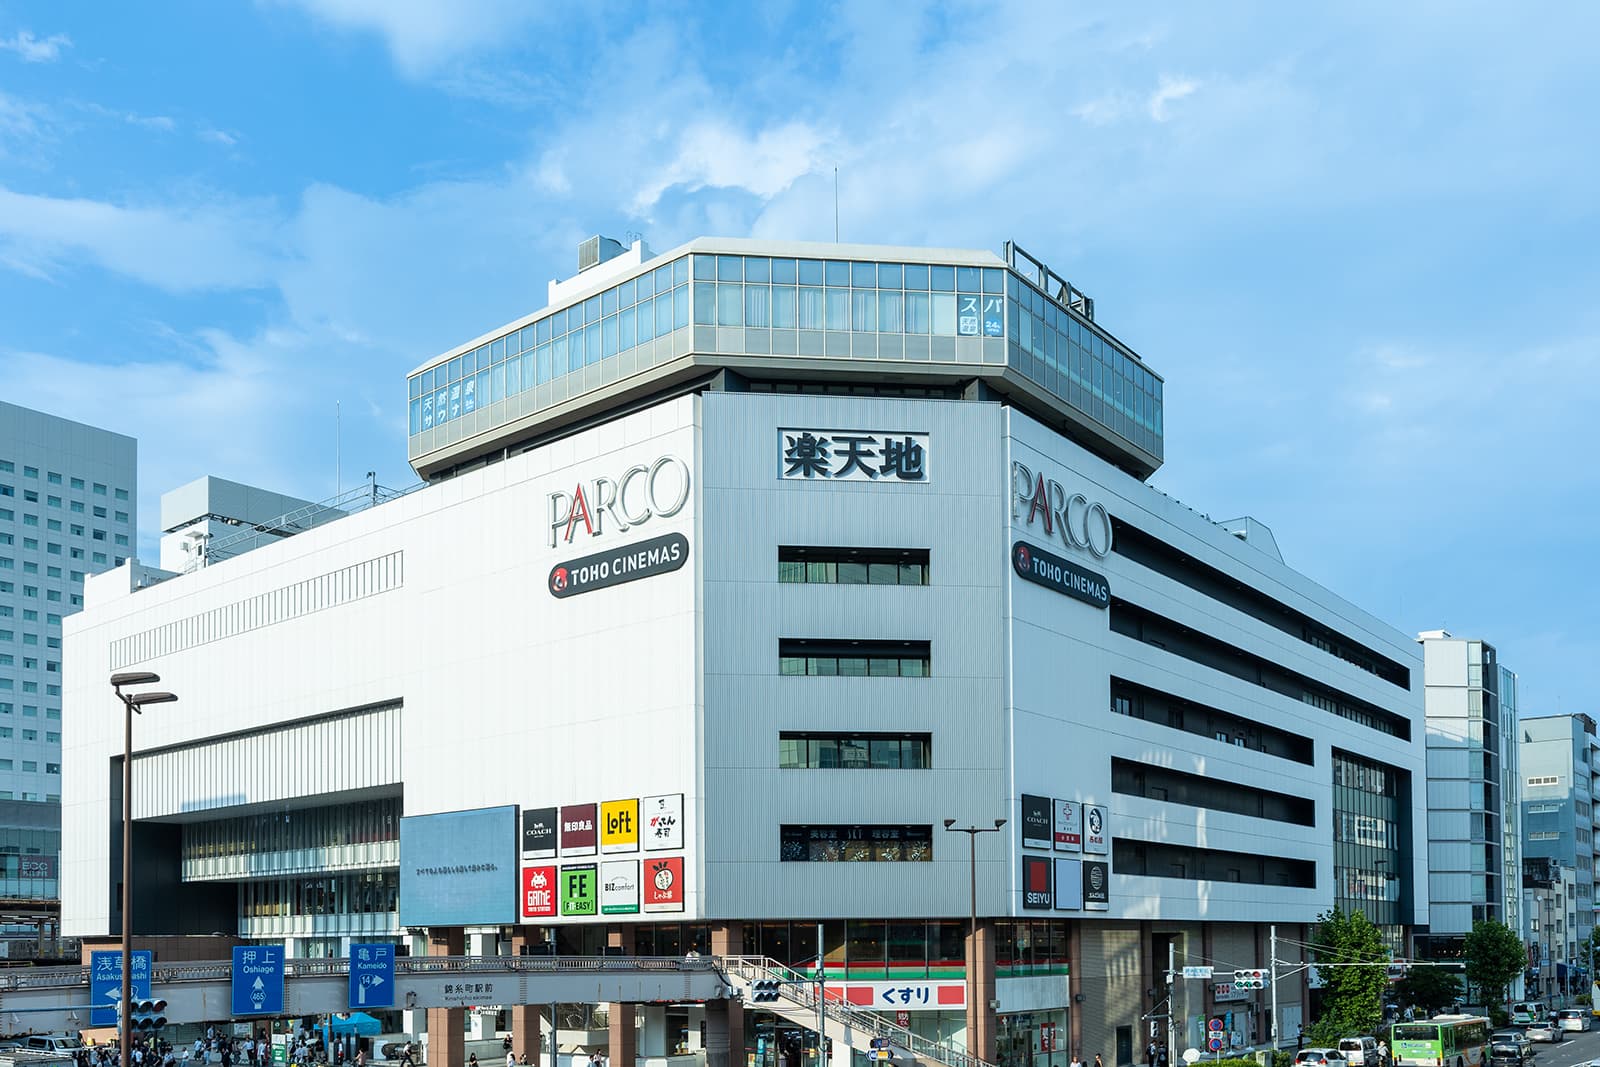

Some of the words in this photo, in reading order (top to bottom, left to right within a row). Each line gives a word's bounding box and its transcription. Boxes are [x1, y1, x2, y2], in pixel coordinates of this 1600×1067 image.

[961, 297, 1003, 313] スパ
[784, 432, 925, 480] 楽天地
[546, 455, 691, 548] PARCO
[1012, 460, 1113, 559] PARCO
[571, 562, 609, 585] TOHO
[612, 543, 681, 575] CINEMAS
[1032, 557, 1062, 583] TOHO
[1063, 570, 1108, 601] CINEMAS
[564, 819, 593, 833] 無印良品
[1026, 816, 1048, 825] COACH
[526, 828, 552, 836] COACH
[22, 862, 48, 871] ECC
[527, 890, 551, 907] GAME
[1027, 892, 1050, 904] SEIYU
[242, 950, 276, 965] 押上
[357, 947, 388, 960] 亀戸
[242, 965, 275, 975] Oshiage
[357, 961, 388, 970] Kameido
[96, 972, 147, 982] Asakusashi
[361, 975, 371, 984] 14
[444, 983, 493, 994] 錦糸町駅前
[252, 992, 265, 1002] 465
[881, 987, 929, 1004] くすり
